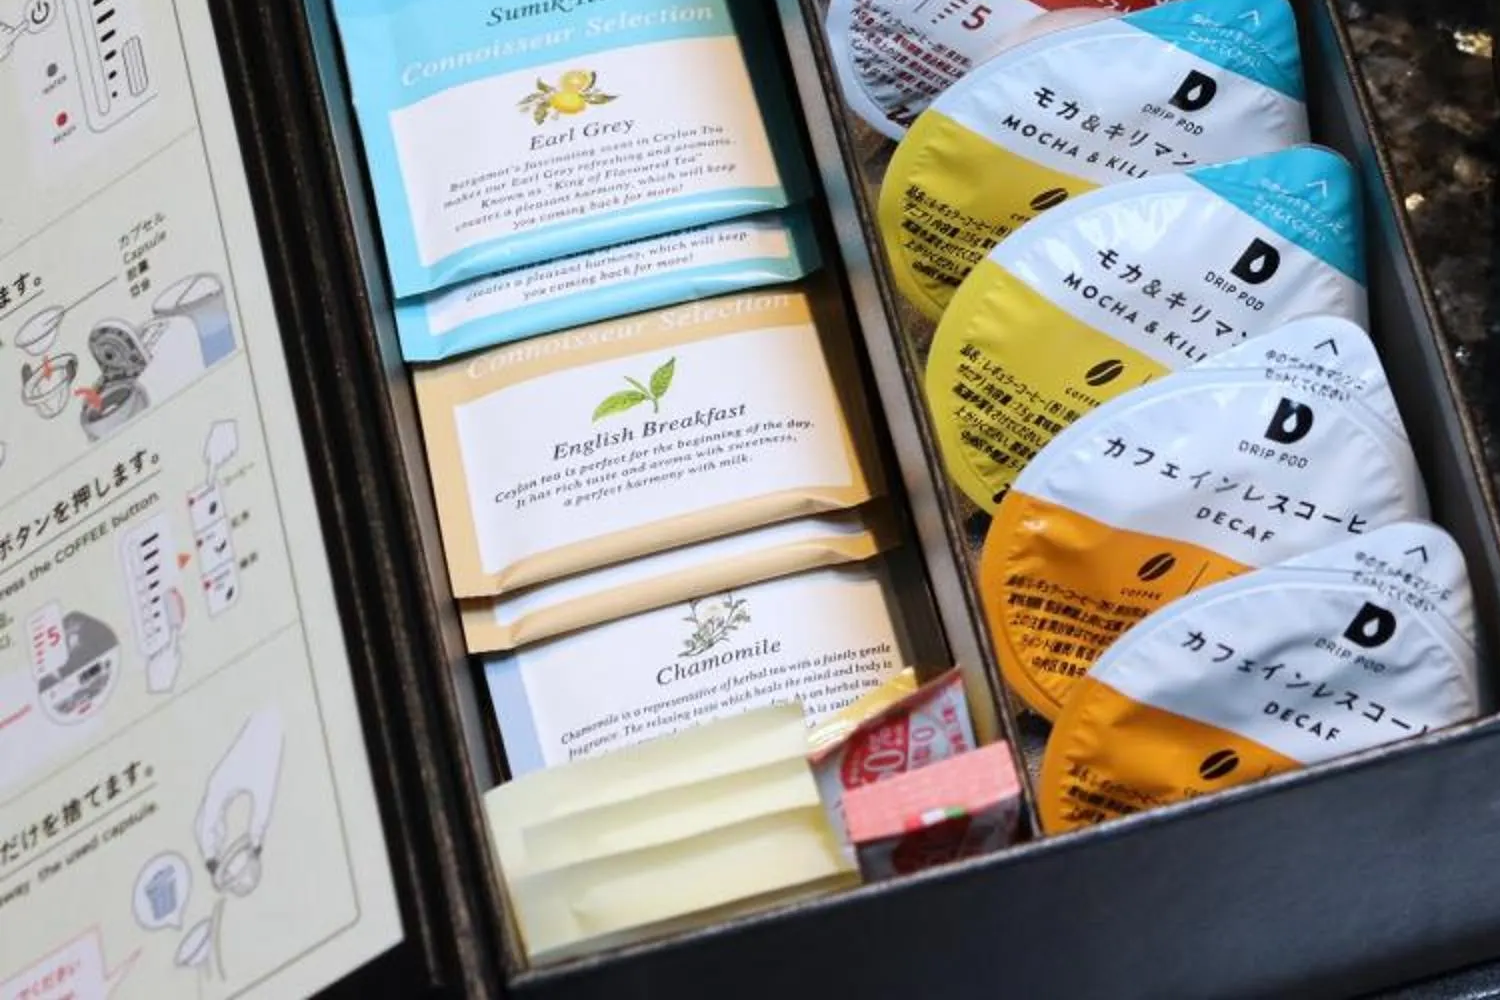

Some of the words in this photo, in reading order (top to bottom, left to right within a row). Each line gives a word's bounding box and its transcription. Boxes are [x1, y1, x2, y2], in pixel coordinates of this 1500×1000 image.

[960, 4, 993, 32] 5
[402, 26, 576, 87] Connoisseur
[585, 4, 714, 38] Selection
[529, 126, 576, 151] Earl
[583, 119, 635, 137] Grey
[1002, 113, 1080, 159] MOCHA
[1086, 151, 1099, 163] &
[1141, 103, 1174, 126] DRIP
[1175, 116, 1204, 136] POD
[485, 182, 507, 194] our
[511, 173, 540, 188] Earl
[543, 167, 575, 180] Grey
[578, 153, 644, 172] refreshing
[647, 145, 671, 158] and
[524, 148, 595, 172] fascinating
[636, 137, 650, 146] in
[653, 129, 697, 143] Ceylon
[481, 191, 525, 209] Known
[587, 172, 601, 184] of
[605, 159, 669, 179] Flavoured
[515, 195, 570, 216] pleasant
[637, 172, 676, 185] which
[679, 165, 703, 178] will
[706, 161, 736, 173] keep
[512, 216, 536, 230] you
[539, 204, 585, 222] coming
[590, 197, 621, 210] back
[623, 191, 642, 205] for
[123, 230, 166, 265] Capsule
[525, 263, 581, 286] pleasant
[649, 240, 687, 256] which
[690, 235, 714, 248] will
[718, 230, 748, 242] keep
[523, 287, 547, 301] you
[550, 275, 597, 293] coming
[599, 266, 631, 281] back
[633, 261, 653, 277] for
[656, 252, 694, 268] more!
[1096, 246, 1247, 347] モカ&キリマ
[1204, 270, 1236, 299] DRIP
[1236, 287, 1265, 312] POD
[1062, 272, 1138, 325] MOCHA
[1144, 320, 1159, 334] &
[467, 317, 650, 380] Connoisseur
[657, 292, 791, 332] Selection
[553, 426, 634, 460] English
[642, 403, 747, 438] Breakfast
[1238, 440, 1276, 462] DRIP
[1277, 452, 1310, 470] POD
[494, 478, 537, 503] Ceylon
[541, 470, 562, 483] tea
[565, 467, 576, 477] is
[579, 454, 626, 476] perfect
[628, 448, 649, 462] for
[653, 442, 673, 455] the
[677, 428, 742, 449] beginning
[745, 423, 760, 434] of
[763, 419, 783, 431] the
[786, 418, 816, 429] day.
[516, 497, 526, 509] It
[529, 489, 551, 503] has
[555, 479, 583, 495] rich
[586, 471, 618, 486] taste
[621, 461, 647, 477] and
[649, 453, 693, 469] aroma
[696, 444, 725, 458] with
[575, 484, 623, 507] perfect
[625, 469, 685, 490] harmony
[688, 460, 717, 474] with
[719, 453, 753, 468] milk.
[1102, 434, 1370, 536] カフェインレスコーヒ
[29, 560, 52, 582] the
[54, 522, 108, 564] COFFEE
[111, 491, 160, 529] button
[1195, 505, 1276, 544] DECAF
[656, 638, 782, 686] Chamomile
[1315, 636, 1350, 662] DRIP
[1352, 653, 1386, 673] POD
[560, 713, 619, 745] Chamomile
[621, 710, 632, 721] is
[643, 684, 719, 714] representative
[720, 676, 732, 692] of
[733, 668, 767, 687] herbal
[769, 665, 787, 676] tea
[788, 658, 812, 672] with
[859, 642, 892, 657] gentle
[623, 723, 643, 737] The
[646, 711, 691, 728] relaxing
[693, 703, 719, 718] taste
[720, 690, 753, 708] which
[754, 681, 783, 696] heals
[785, 676, 802, 688] the
[803, 669, 831, 684] mind
[832, 665, 853, 678] and
[855, 660, 882, 674] body
[825, 679, 859, 695] herbal
[1181, 629, 1428, 736] カフェインレスコー
[1263, 701, 1341, 742] DECAF
[38, 861, 62, 883] the
[65, 834, 99, 866] used
[102, 801, 157, 843] capsule
